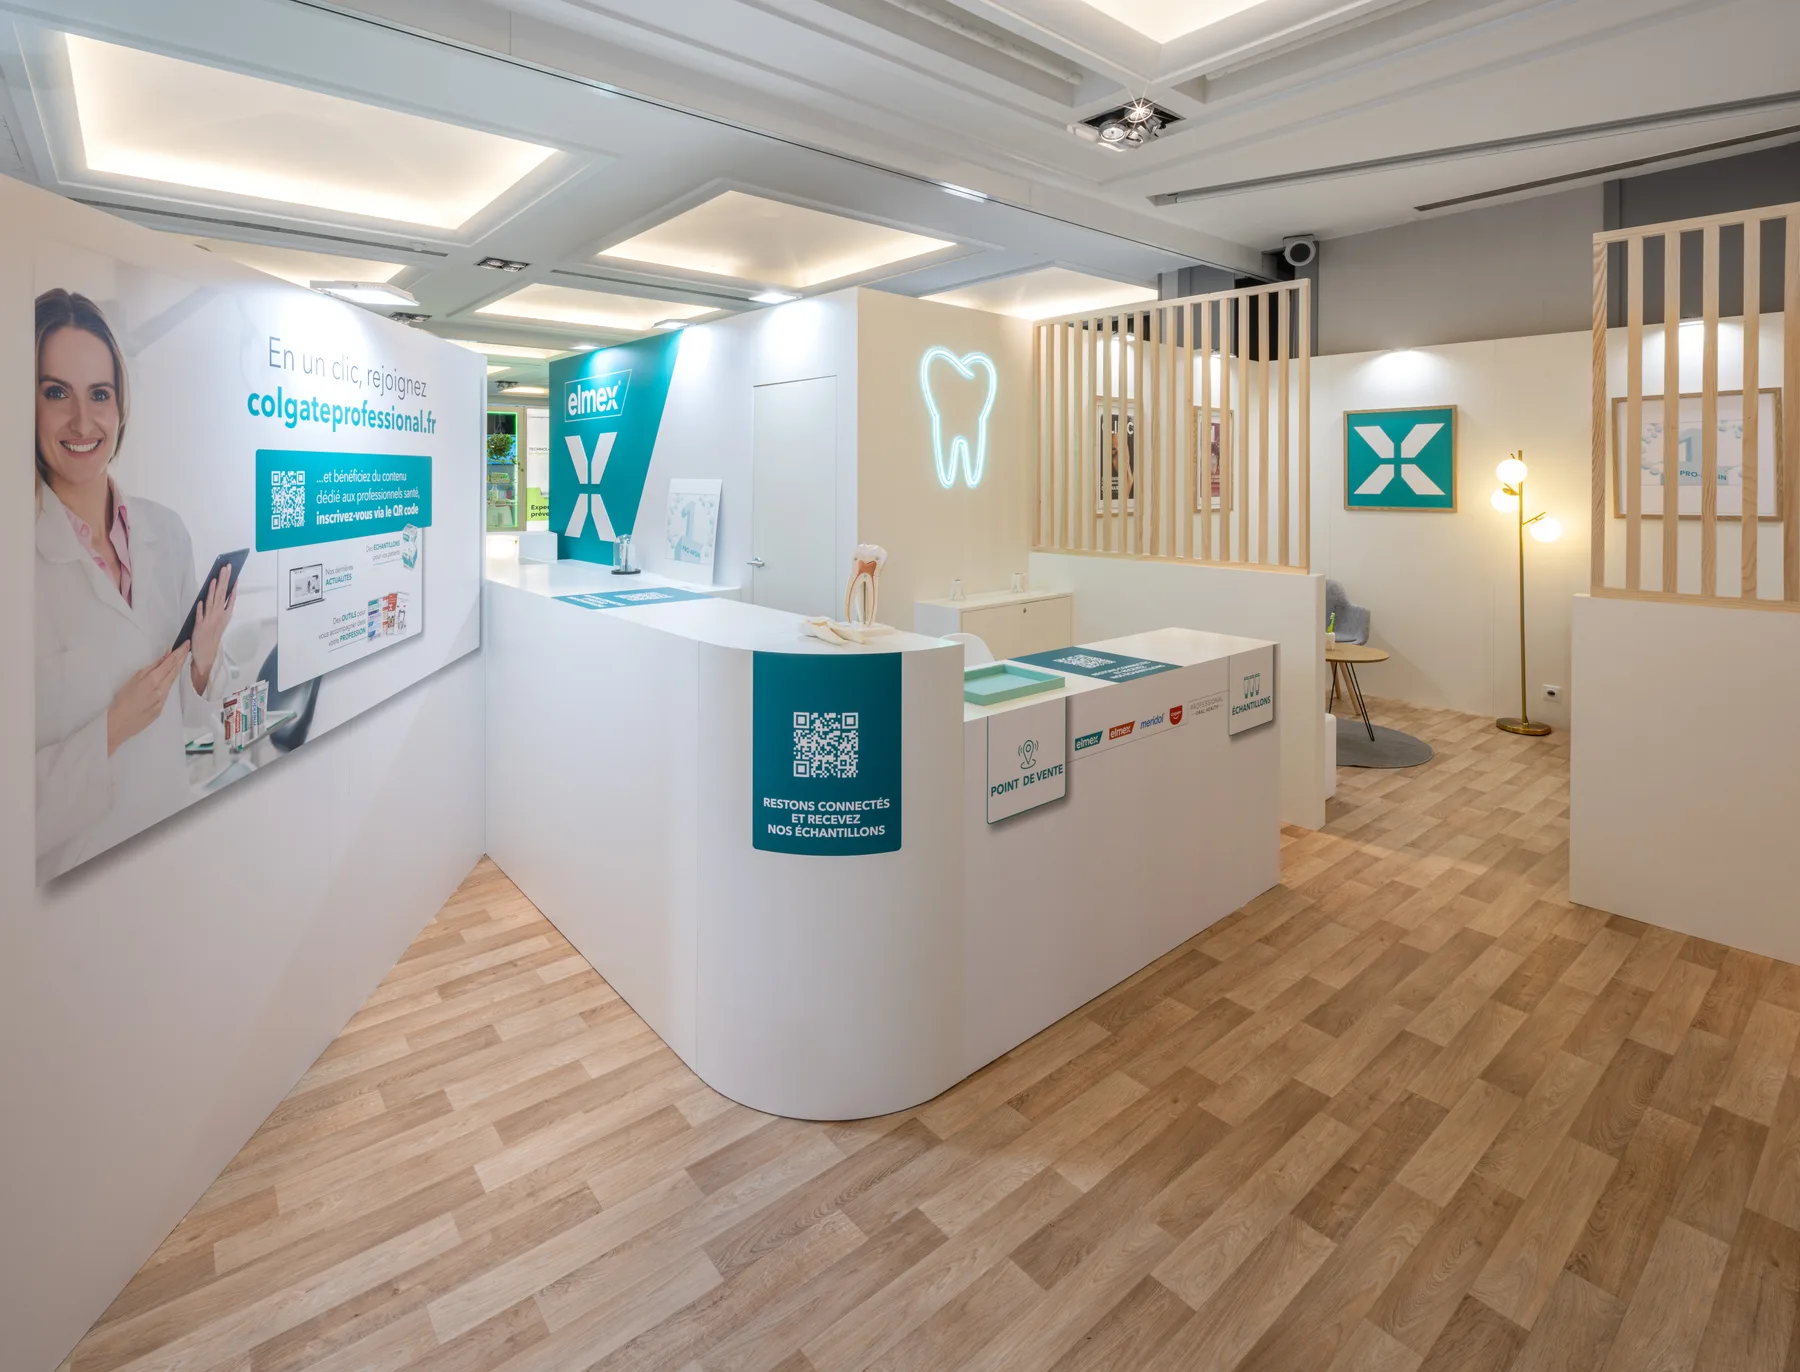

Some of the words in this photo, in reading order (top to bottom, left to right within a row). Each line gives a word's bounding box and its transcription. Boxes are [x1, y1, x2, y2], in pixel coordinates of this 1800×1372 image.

[269, 336, 295, 371] En
[303, 353, 325, 377] un
[332, 353, 362, 389] clic,
[367, 365, 427, 400] rejoignez
[568, 382, 619, 416] elmex
[247, 386, 436, 434] colgateprofessional.fr
[333, 469, 371, 483] bénéficiez
[372, 469, 380, 482] du
[382, 472, 407, 482] contenu
[316, 489, 340, 504] dédié
[342, 492, 355, 503] aux
[357, 487, 402, 505] professionnels
[403, 486, 420, 499] santé,
[316, 509, 373, 525] inscrivez-vous
[374, 506, 384, 518] via
[385, 505, 392, 517] le
[393, 504, 403, 517] QR
[404, 503, 419, 515] code
[341, 611, 357, 622] OUTILS
[1232, 696, 1271, 716] ÉCHANTILLONS
[1140, 713, 1164, 729] meridol
[1110, 725, 1131, 739] elmex
[1076, 735, 1099, 749] elmex
[991, 778, 1020, 797] POINT
[1023, 773, 1035, 786] DE
[1036, 763, 1063, 781] VENTE
[763, 797, 815, 811] RESTONS
[818, 797, 890, 812] CONNECTÉS
[791, 813, 805, 824] ET
[808, 814, 861, 825] RECEVEZ
[767, 824, 792, 836] NOS
[795, 825, 885, 838] ÉCHANTILLONS
